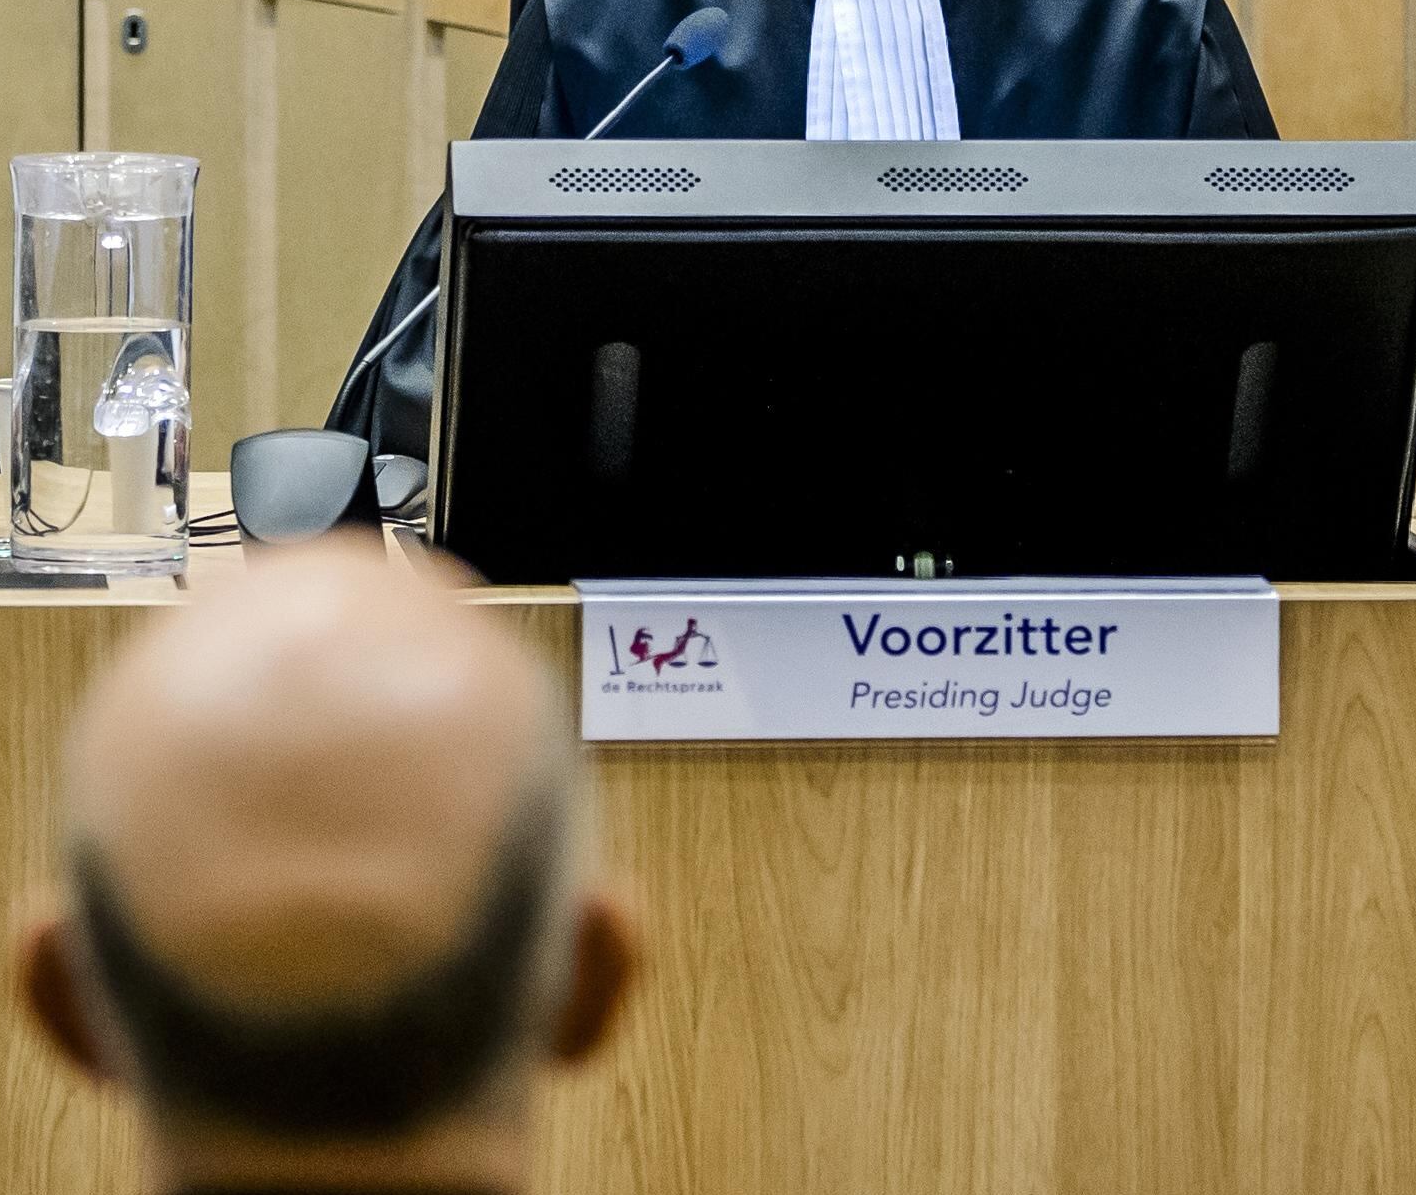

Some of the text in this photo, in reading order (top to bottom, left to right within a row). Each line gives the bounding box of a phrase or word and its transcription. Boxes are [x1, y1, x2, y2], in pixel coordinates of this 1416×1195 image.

[841, 612, 1119, 658] Voorzitter
[601, 679, 724, 696] de Rechtspraak
[849, 678, 1113, 717] Presiding Judge
